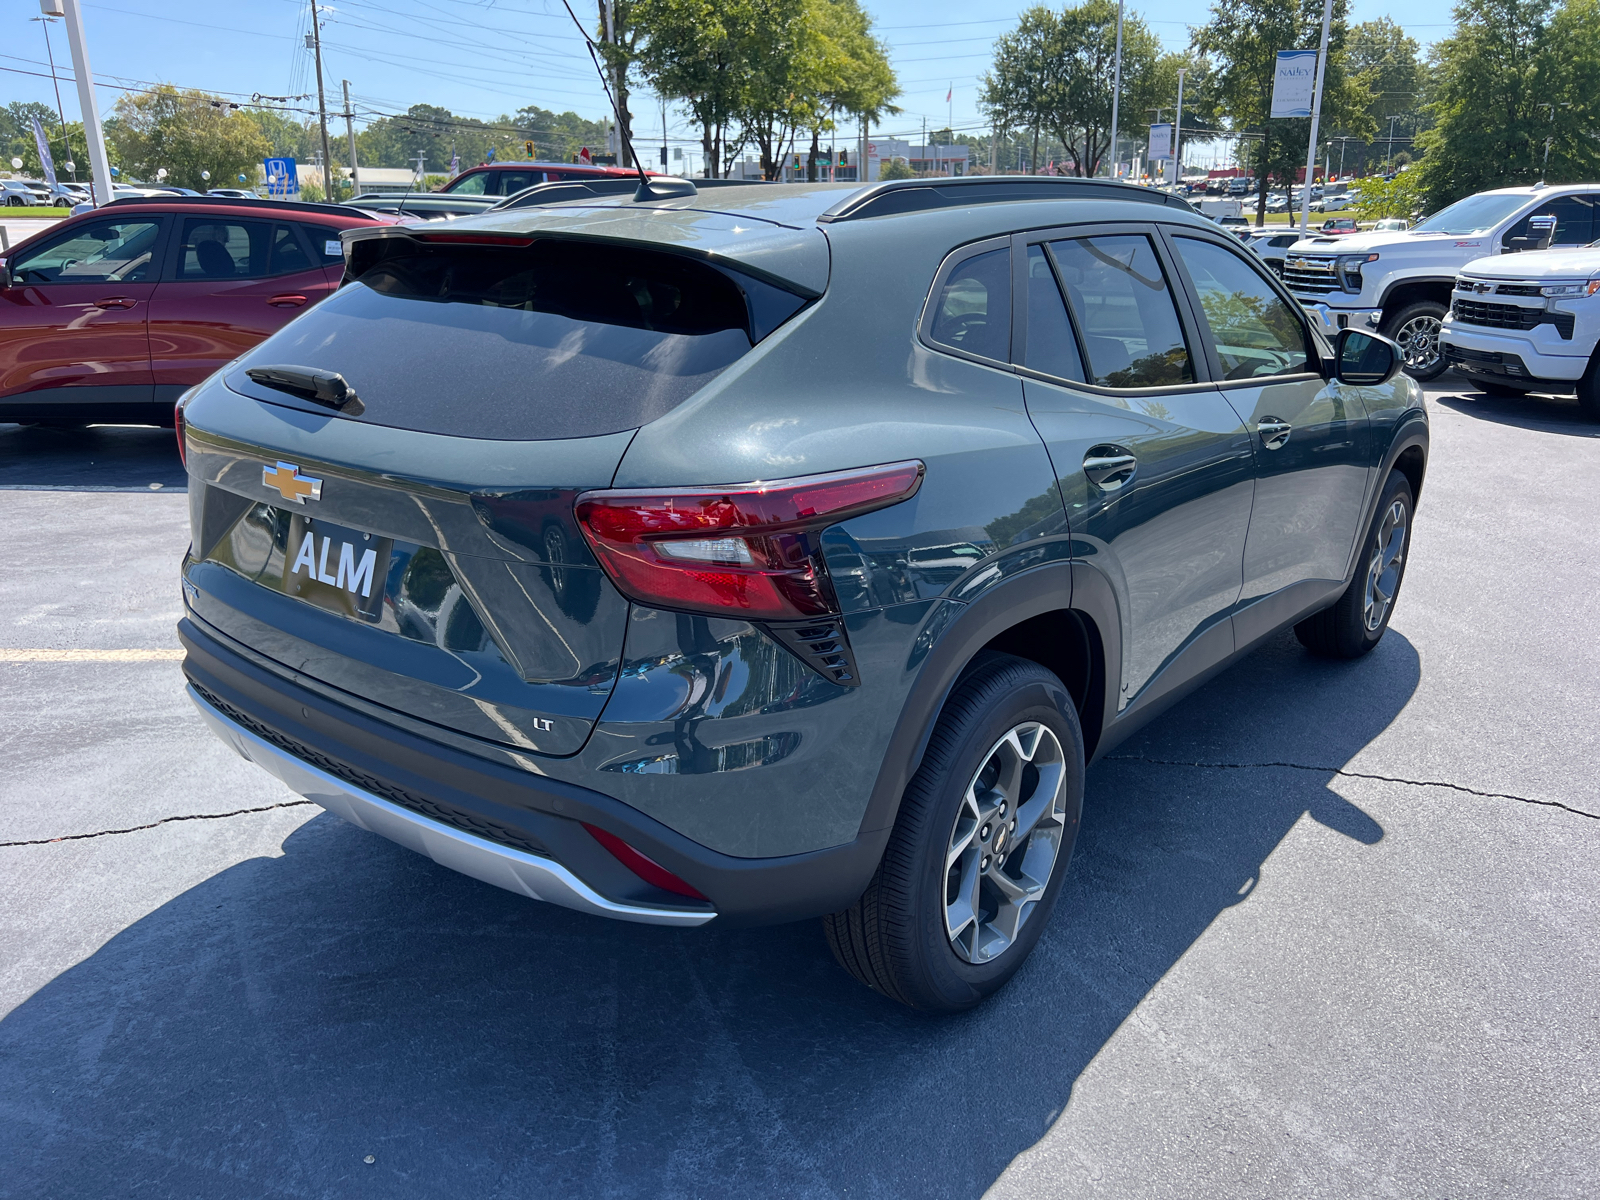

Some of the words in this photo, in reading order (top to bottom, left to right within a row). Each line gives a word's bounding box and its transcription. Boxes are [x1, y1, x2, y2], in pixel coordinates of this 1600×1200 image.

[1280, 66, 1312, 76] NALLEY
[292, 531, 377, 598] ALM
[533, 717, 554, 731] LT
